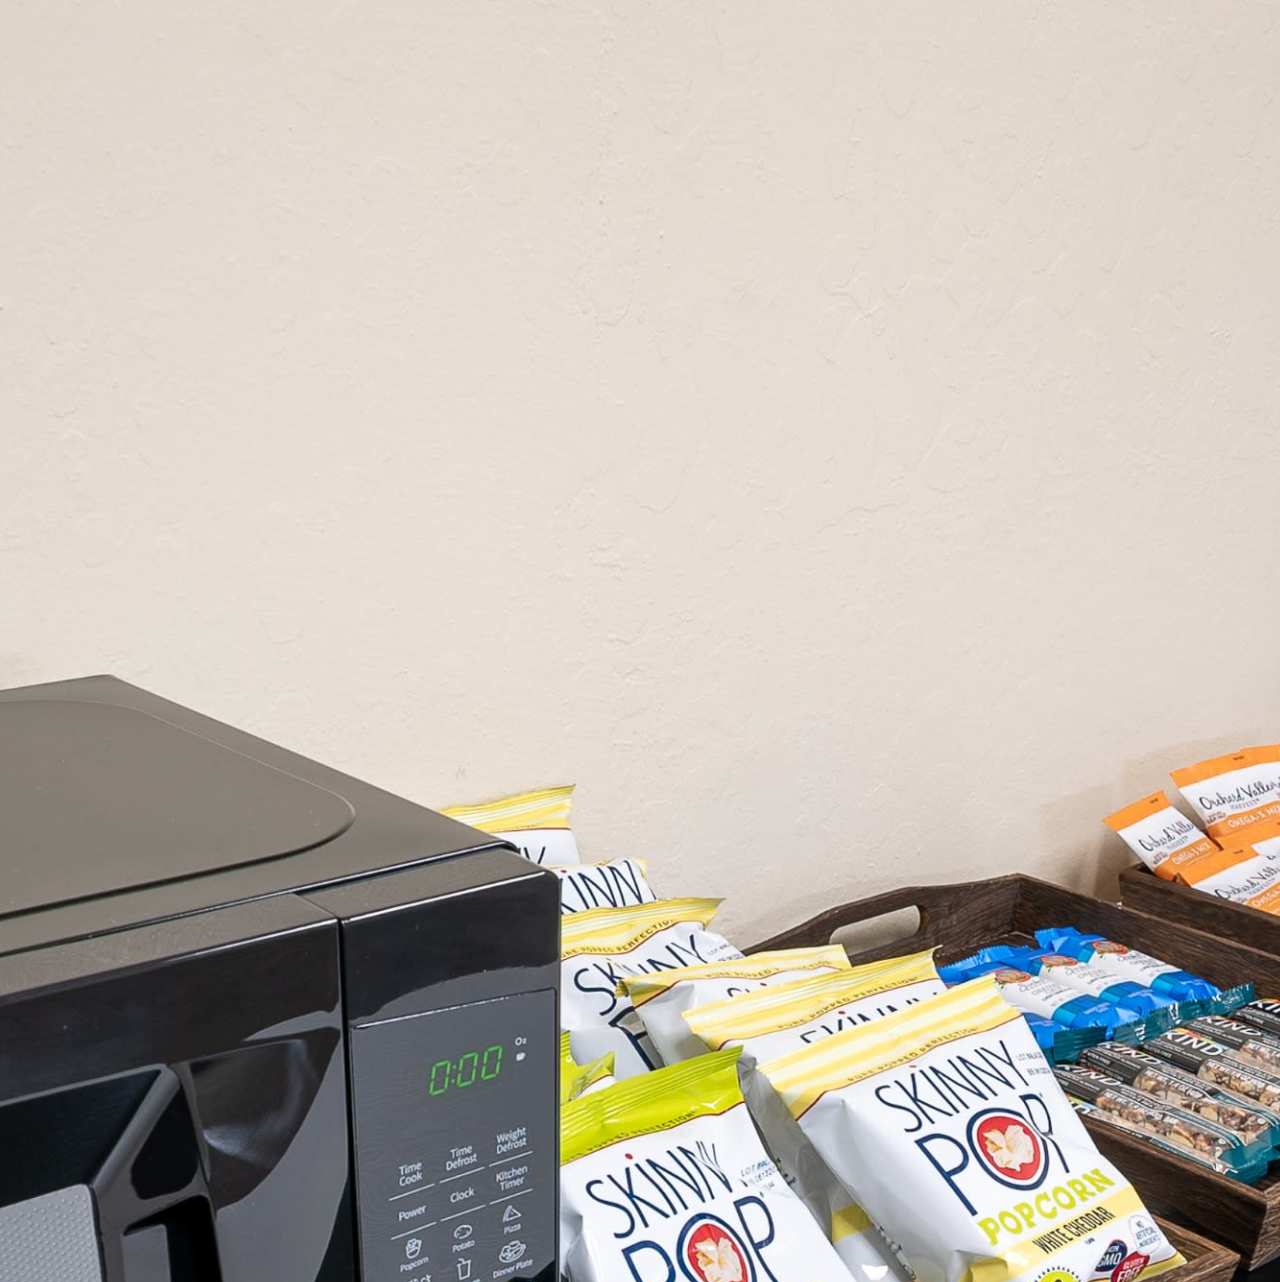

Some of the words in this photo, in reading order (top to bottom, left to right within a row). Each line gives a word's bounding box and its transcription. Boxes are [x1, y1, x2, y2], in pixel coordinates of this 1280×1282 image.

[1240, 780, 1271, 798] Valle
[1163, 1030, 1223, 1056] KIND
[429, 1045, 504, 1097] 0:00
[875, 1040, 1030, 1133] SKINNY
[496, 1127, 527, 1144] Weight
[450, 1145, 473, 1159] Time
[496, 1137, 527, 1154] Defrost
[446, 1154, 478, 1171] Defrost
[914, 1093, 1069, 1216] POP
[398, 1162, 423, 1176] Time
[496, 1166, 528, 1182] Kitchen
[399, 1172, 423, 1187] Cook
[499, 1176, 525, 1191] Timer
[450, 1187, 475, 1203] Clock
[585, 1140, 733, 1239] SKINNY
[398, 1205, 427, 1221] Power
[978, 1168, 1117, 1246] POPCORN
[503, 1223, 521, 1235] Pizza
[1032, 1227, 1074, 1254] WHITE
[1069, 1205, 1117, 1238] CHEDDAR
[452, 1239, 476, 1253] Potato
[399, 1256, 430, 1273] Popcorn
[492, 1264, 515, 1279] Dinner
[514, 1259, 534, 1271] Plate
